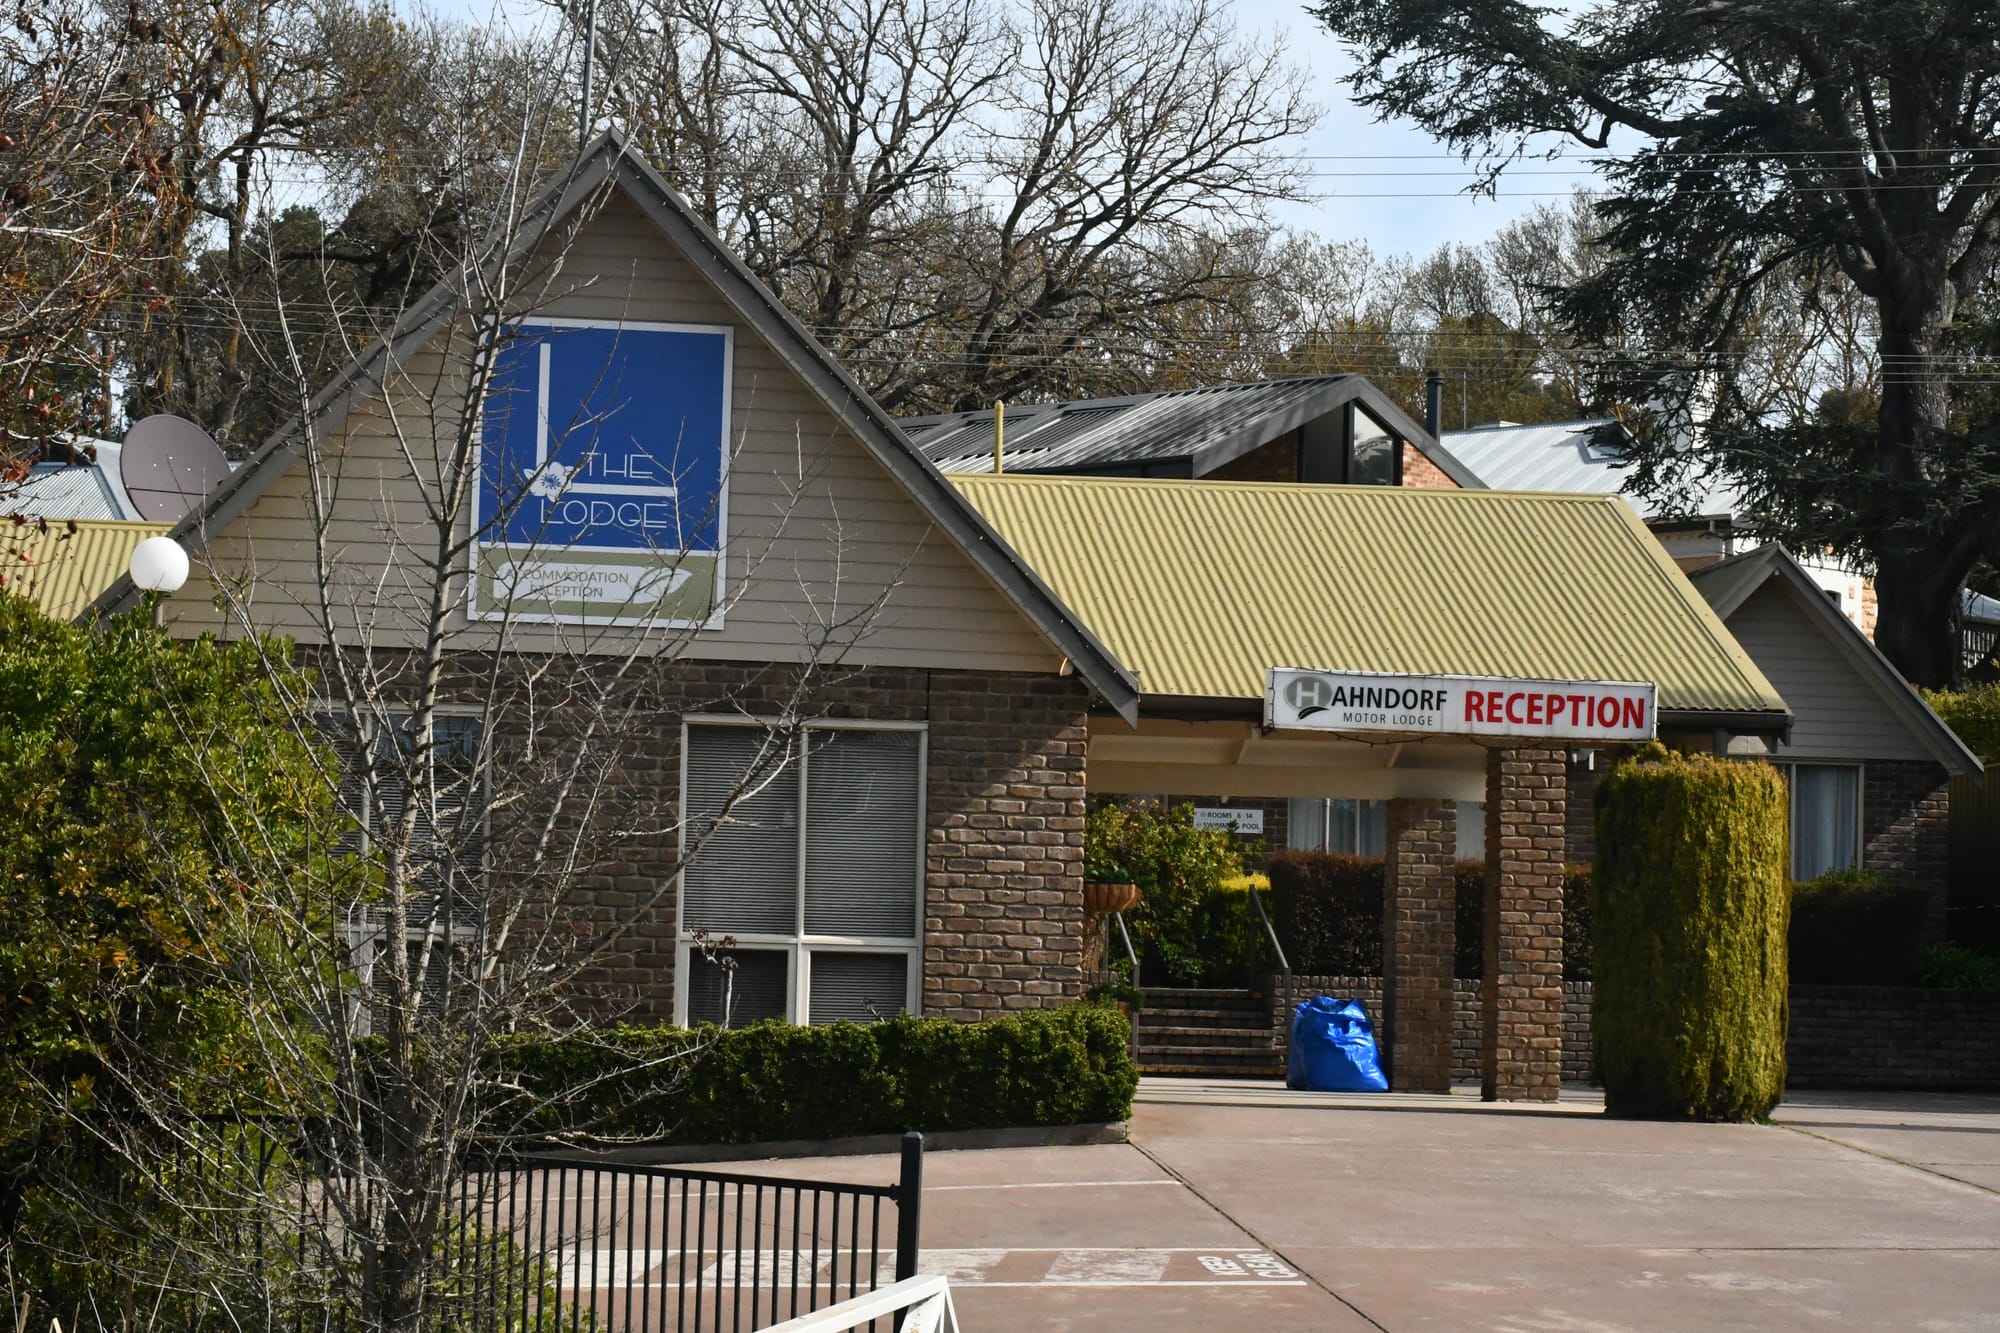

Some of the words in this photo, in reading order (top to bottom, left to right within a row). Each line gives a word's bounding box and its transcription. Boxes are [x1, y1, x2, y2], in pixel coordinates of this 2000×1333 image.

[581, 452, 654, 479] THE
[541, 499, 668, 529] LODGE
[505, 568, 629, 583] ACOMMODATION
[1343, 712, 1386, 724] MOTOR
[1392, 715, 1433, 726] LODGE
[1464, 690, 1645, 729] RECEPTION
[1196, 1256, 1250, 1275] KEEP
[1236, 1253, 1298, 1278] CLEAR
